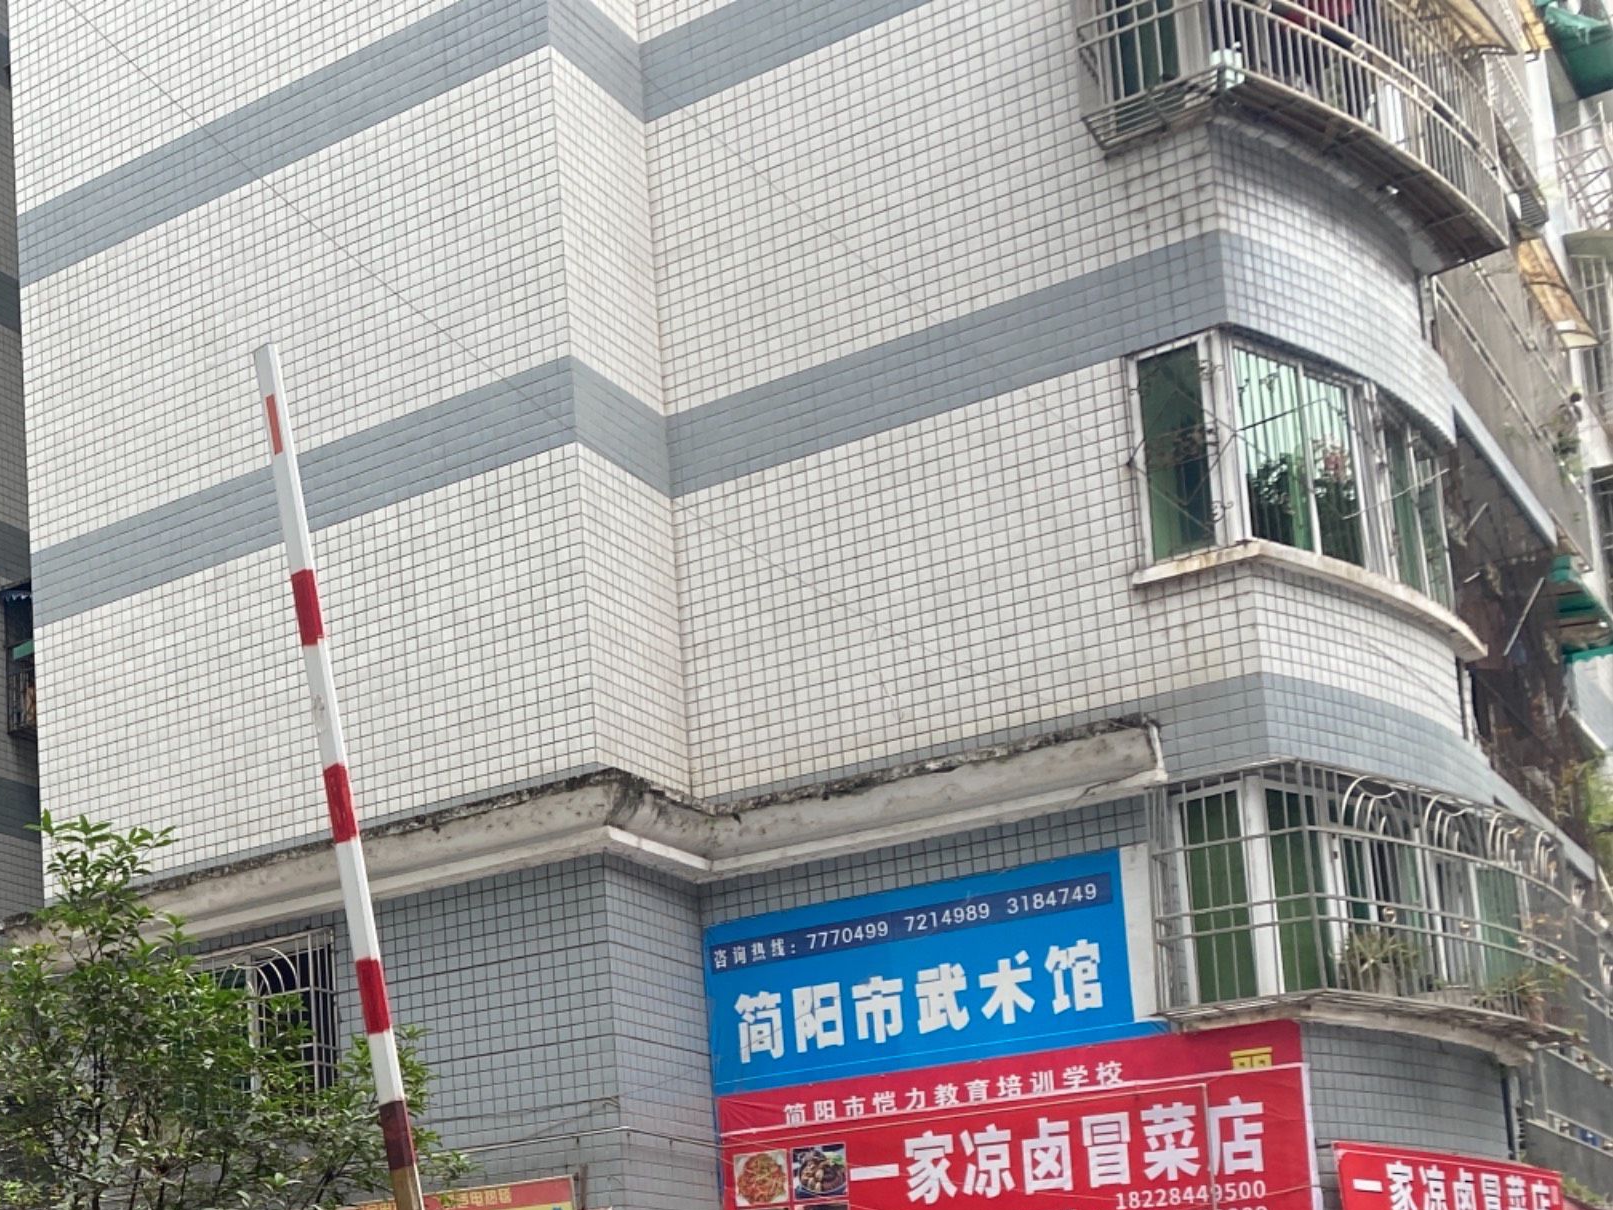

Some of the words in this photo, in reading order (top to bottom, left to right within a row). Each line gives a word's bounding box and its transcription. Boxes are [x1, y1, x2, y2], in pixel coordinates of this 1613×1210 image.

[806, 920, 889, 950] 7770499
[904, 902, 990, 932] 7214989
[1007, 882, 1097, 915] 3184749
[734, 939, 1103, 1064] 简阳市武术馆
[783, 1060, 1123, 1128] 简阳市恺力教育培训学校
[850, 1096, 1265, 1205] 一家凉卤冒菜店
